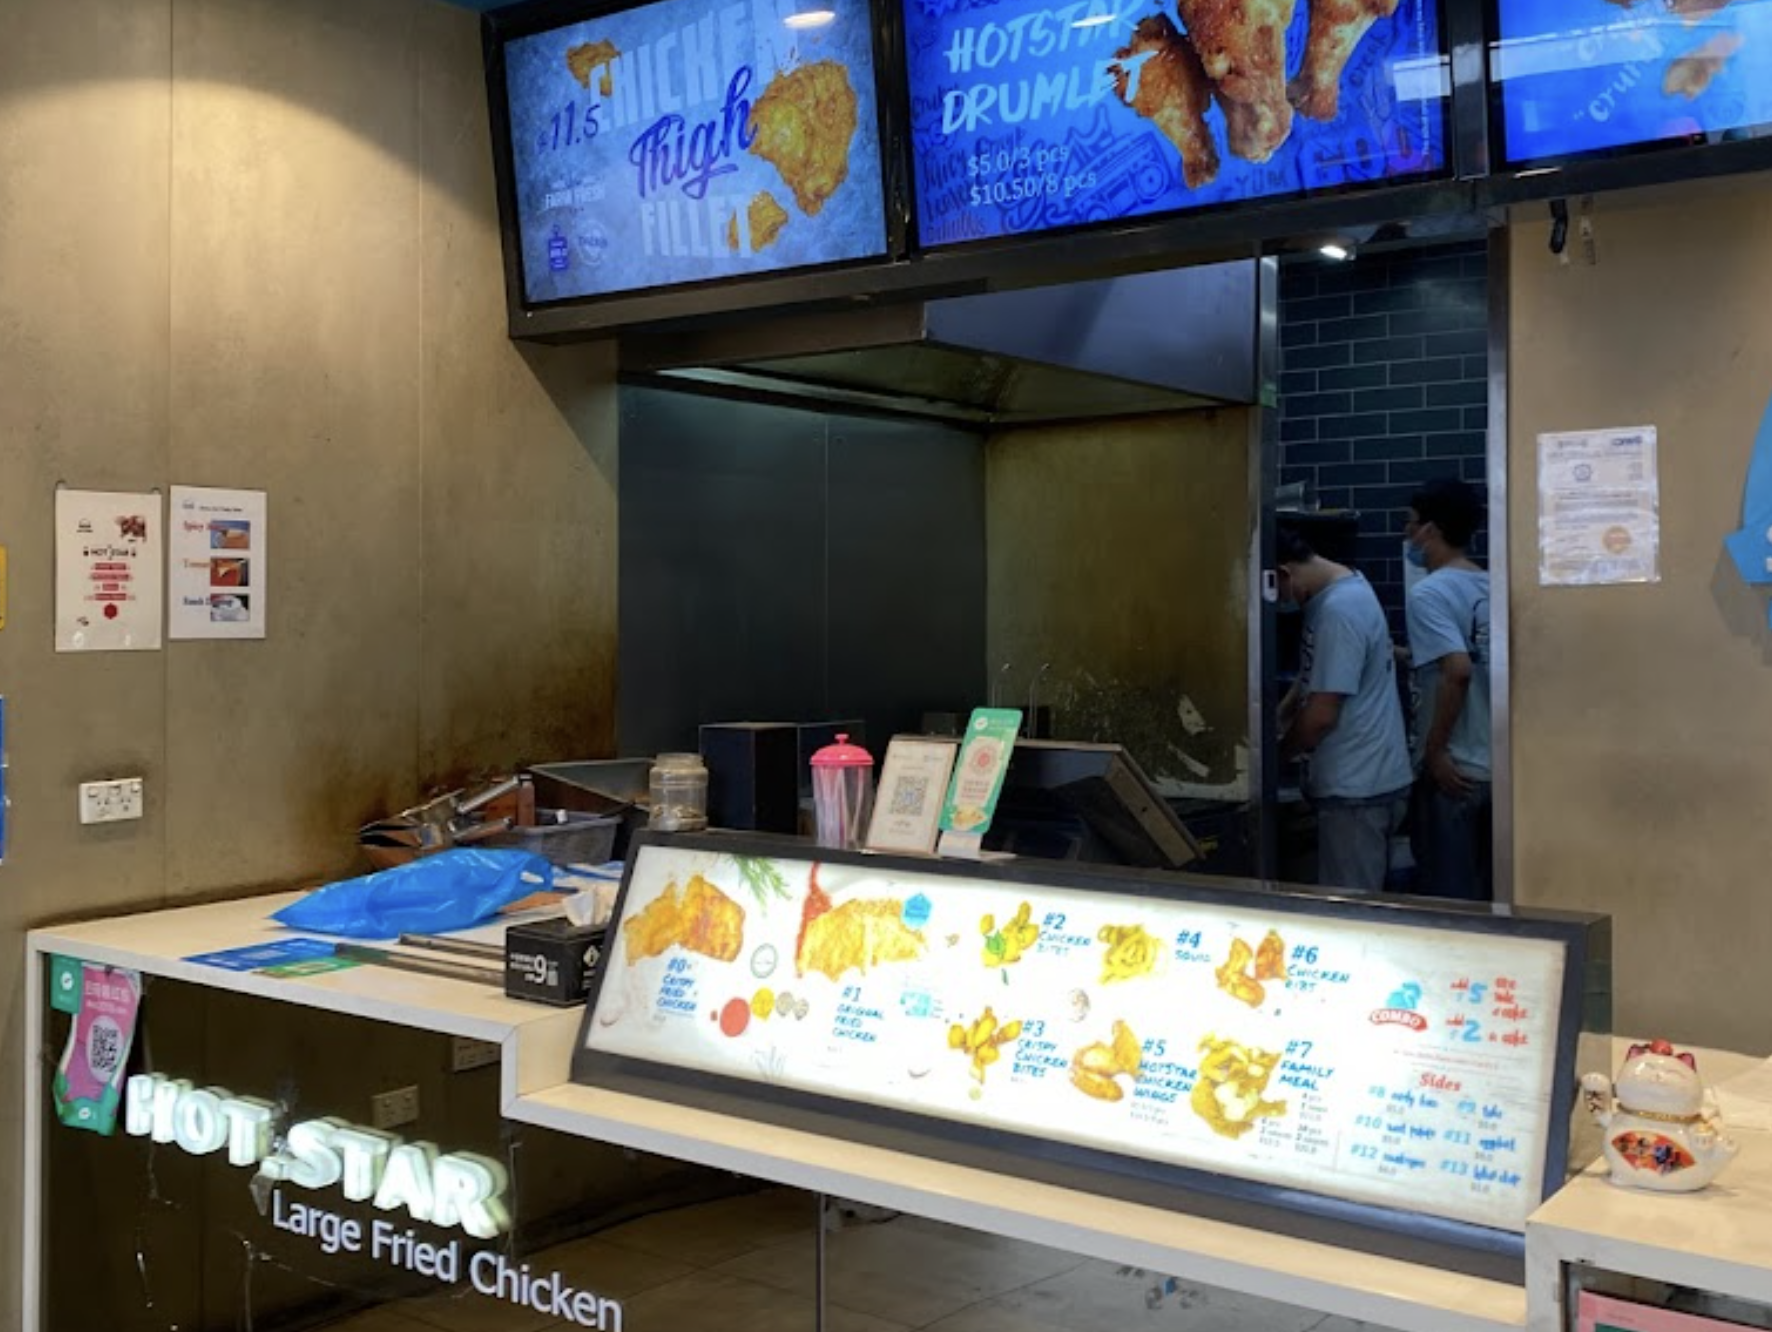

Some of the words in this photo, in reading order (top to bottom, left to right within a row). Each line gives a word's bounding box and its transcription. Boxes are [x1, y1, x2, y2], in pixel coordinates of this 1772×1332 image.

[943, 0, 1143, 72] HOTSTAR
[589, 0, 798, 132] CHICKEN
[942, 50, 1159, 134] DRUMLET
[629, 65, 758, 199] Thigh
[1037, 145, 1069, 170] pcs
[970, 175, 1058, 207] $10.50/8
[1063, 173, 1097, 197] pcs
[640, 198, 753, 259] FILLET
[1042, 911, 1067, 930] #2
[1039, 930, 1092, 947] CHICKEN
[1176, 929, 1203, 948] #4
[1290, 944, 1320, 965] #6
[1287, 963, 1352, 984] CHICKEN
[841, 985, 862, 1003] #1
[1021, 1019, 1046, 1038] #3
[1015, 1047, 1069, 1069] CHICKEN
[1140, 1037, 1168, 1058] #5
[1285, 1039, 1314, 1059] #7
[1012, 1061, 1047, 1078] BITES
[1137, 1059, 1198, 1082] HOTSTAR
[1280, 1060, 1336, 1079] FAMILY
[1278, 1074, 1319, 1091] MEAL
[1418, 1071, 1462, 1092] Sides
[272, 1188, 362, 1254] Large
[371, 1218, 458, 1283] Fried
[469, 1250, 623, 1332] Chicken
